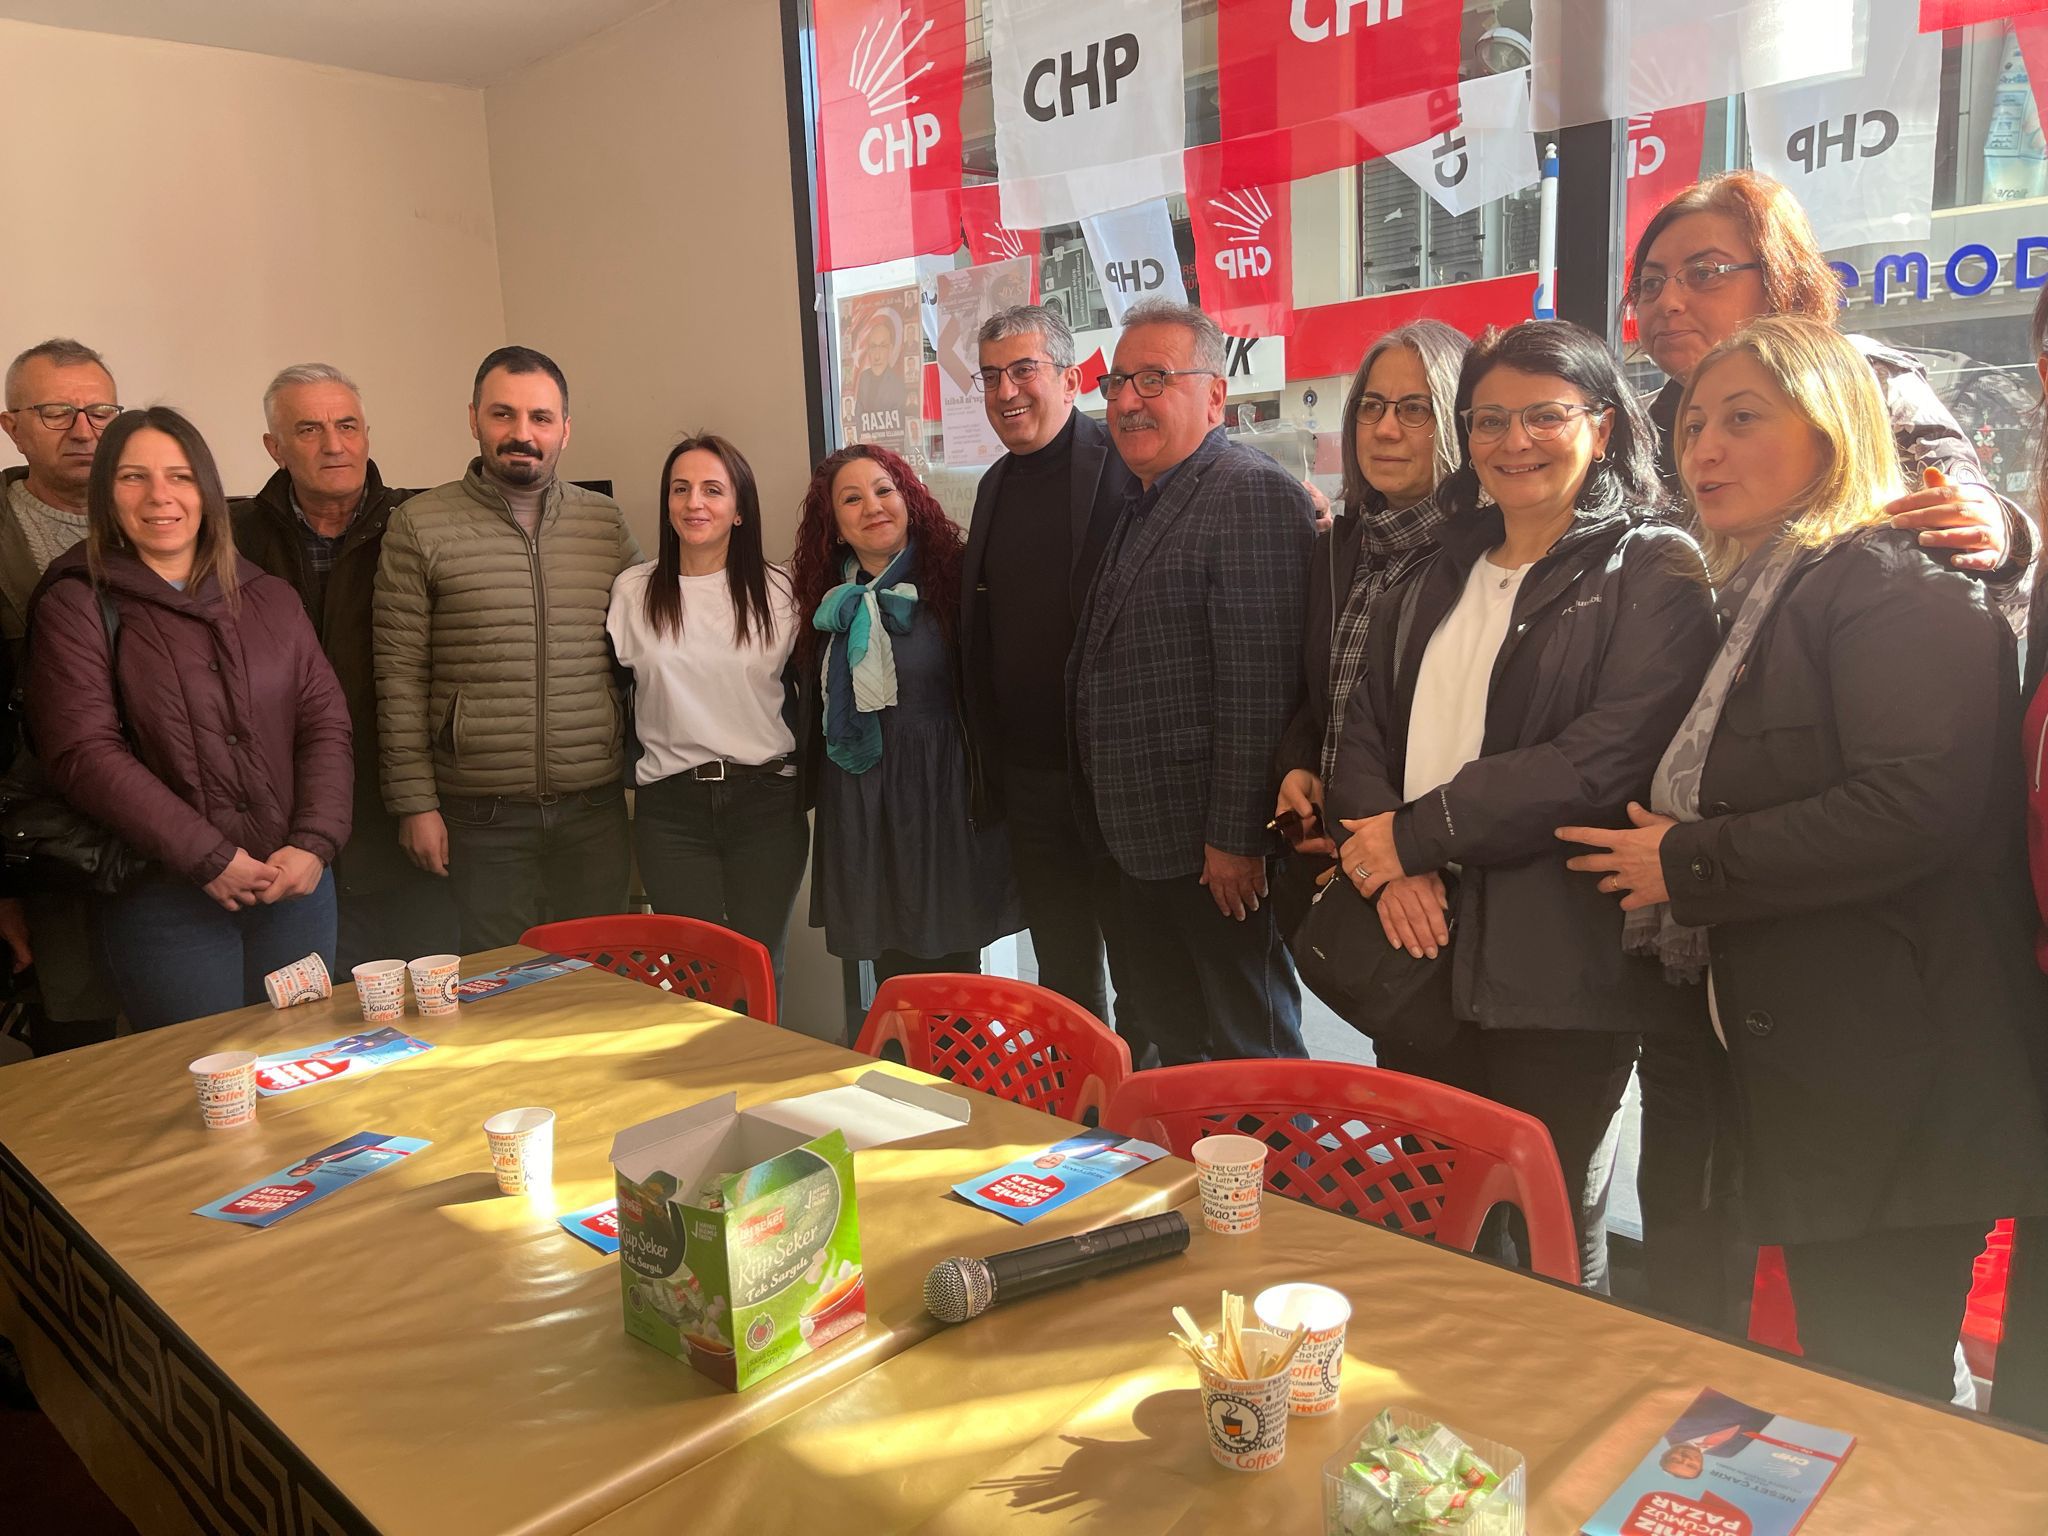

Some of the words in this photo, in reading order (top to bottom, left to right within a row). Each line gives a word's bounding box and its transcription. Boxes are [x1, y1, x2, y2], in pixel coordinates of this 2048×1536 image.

[1023, 33, 1140, 122] CHP
[859, 113, 941, 175] CHP
[1427, 88, 1469, 188] CHP
[369, 1003, 395, 1012] Kakao
[213, 1090, 245, 1103] Coffee
[260, 1187, 308, 1197] PAZAR
[1011, 1174, 1059, 1193] PAZAR
[638, 1231, 668, 1259] Şeker
[738, 1250, 773, 1289] Küp
[773, 1226, 818, 1267] Şeker
[745, 1283, 769, 1302] Tek
[1236, 1449, 1280, 1470] Coffee
[1651, 1494, 1742, 1532] PAZAR
